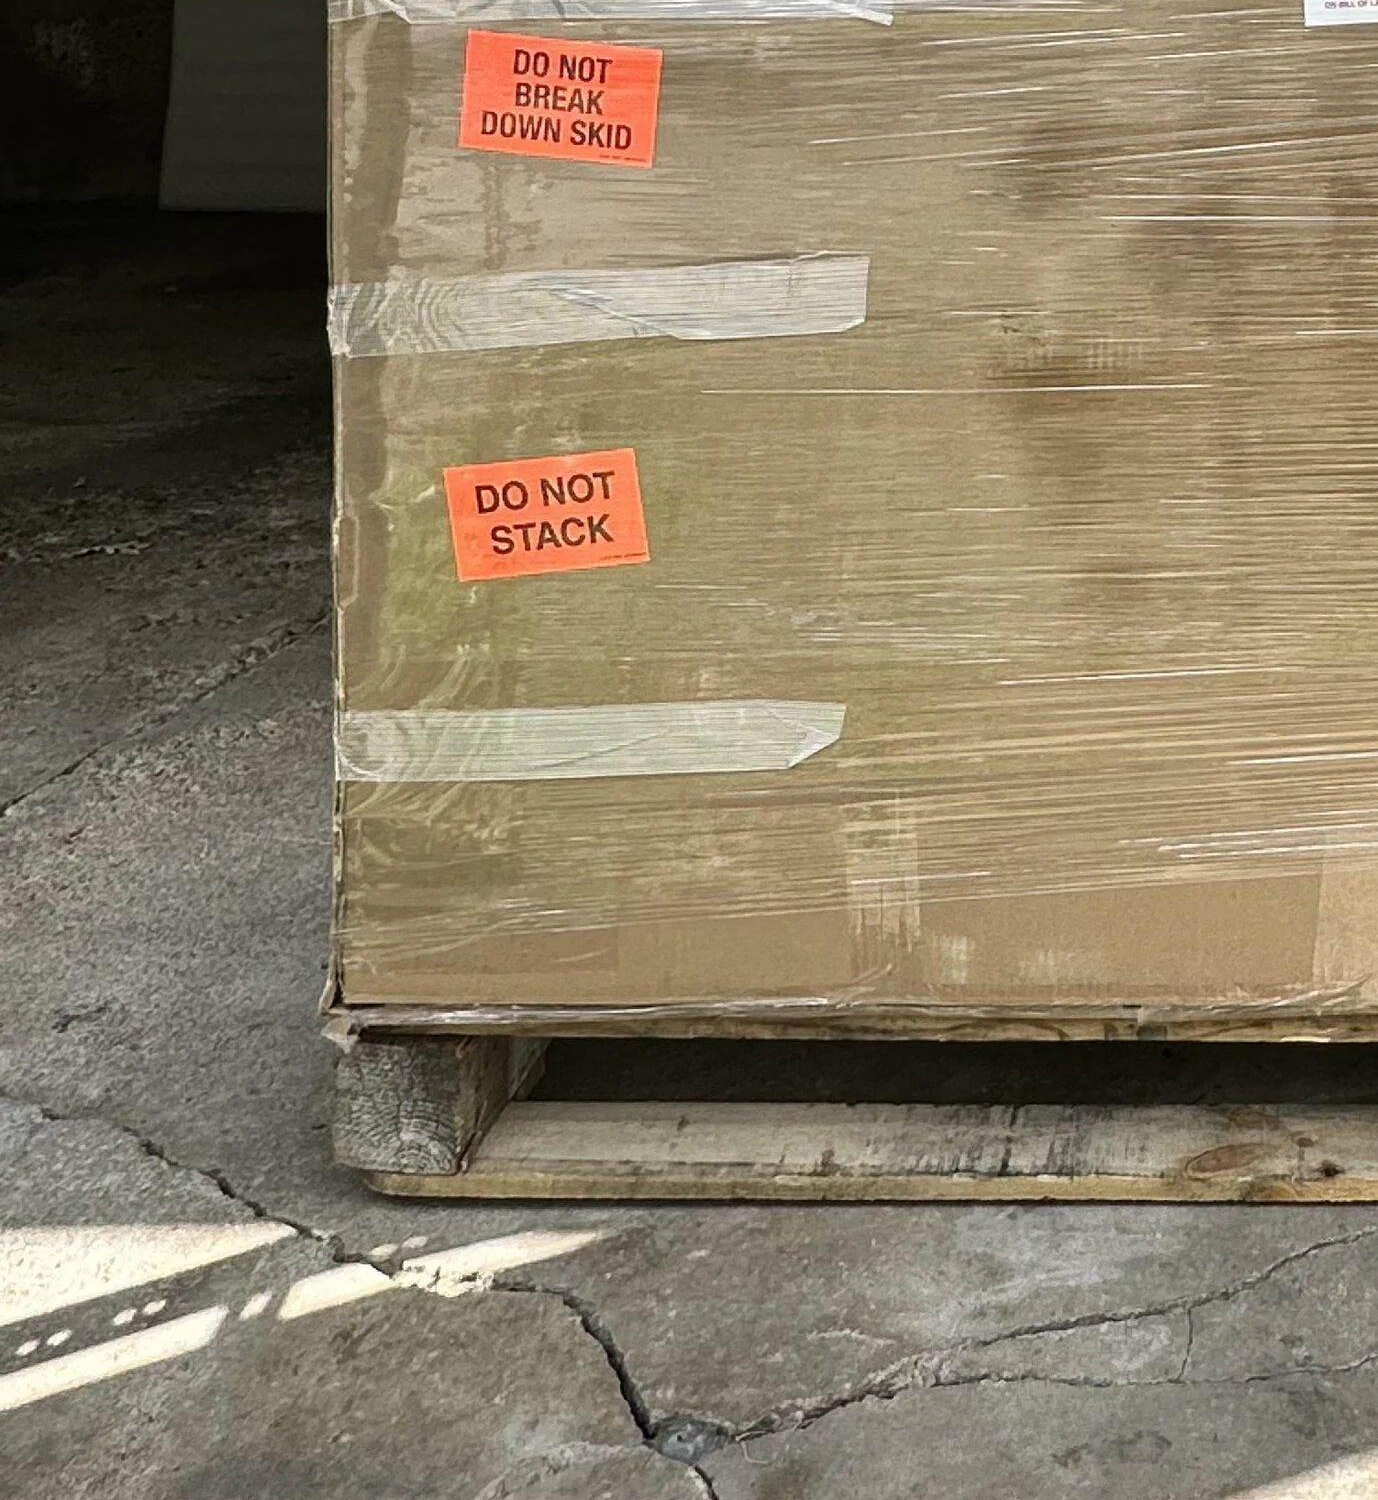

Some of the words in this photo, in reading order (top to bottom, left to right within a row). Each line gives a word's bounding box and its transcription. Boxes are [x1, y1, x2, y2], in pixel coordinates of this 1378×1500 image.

[513, 49, 549, 78] DO
[559, 54, 613, 84] NOT
[515, 82, 605, 115] BREAK
[481, 111, 560, 143] DOWN
[570, 119, 632, 150] SKID
[474, 480, 529, 514] DO
[540, 470, 615, 507] NOT
[491, 513, 614, 555] STACK
